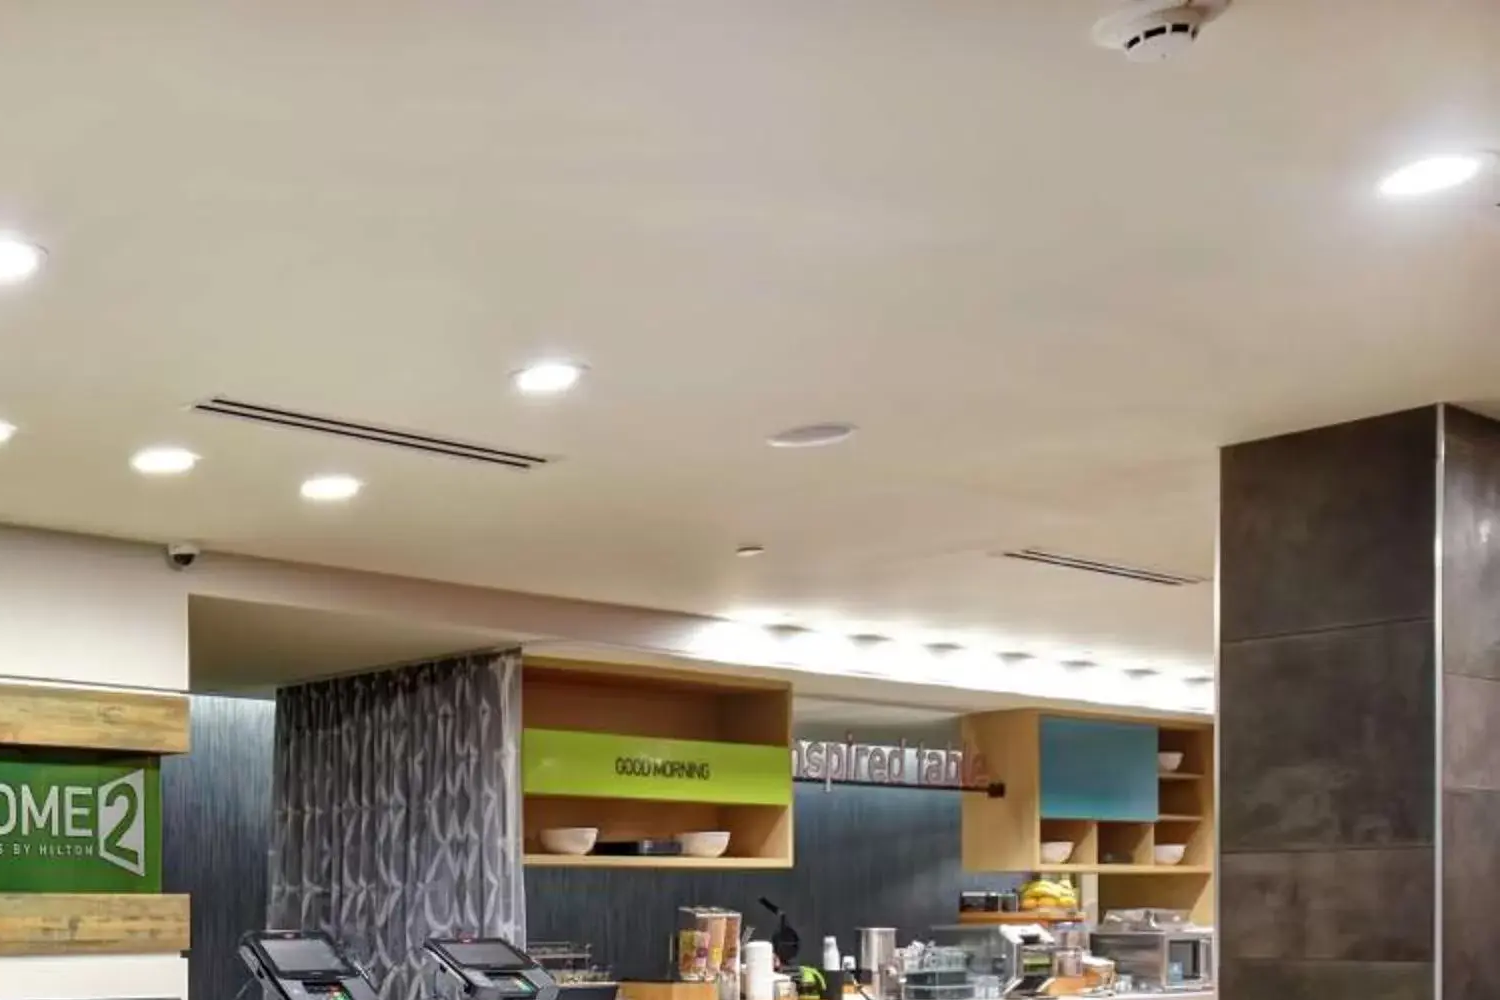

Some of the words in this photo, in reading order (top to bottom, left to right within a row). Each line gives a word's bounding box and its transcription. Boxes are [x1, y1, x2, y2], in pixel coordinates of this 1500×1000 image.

[615, 756, 651, 777] GOOD
[652, 760, 710, 780] MORNING
[792, 731, 905, 793] nspired
[13, 844, 32, 857] BY
[39, 845, 95, 857] HILTON
